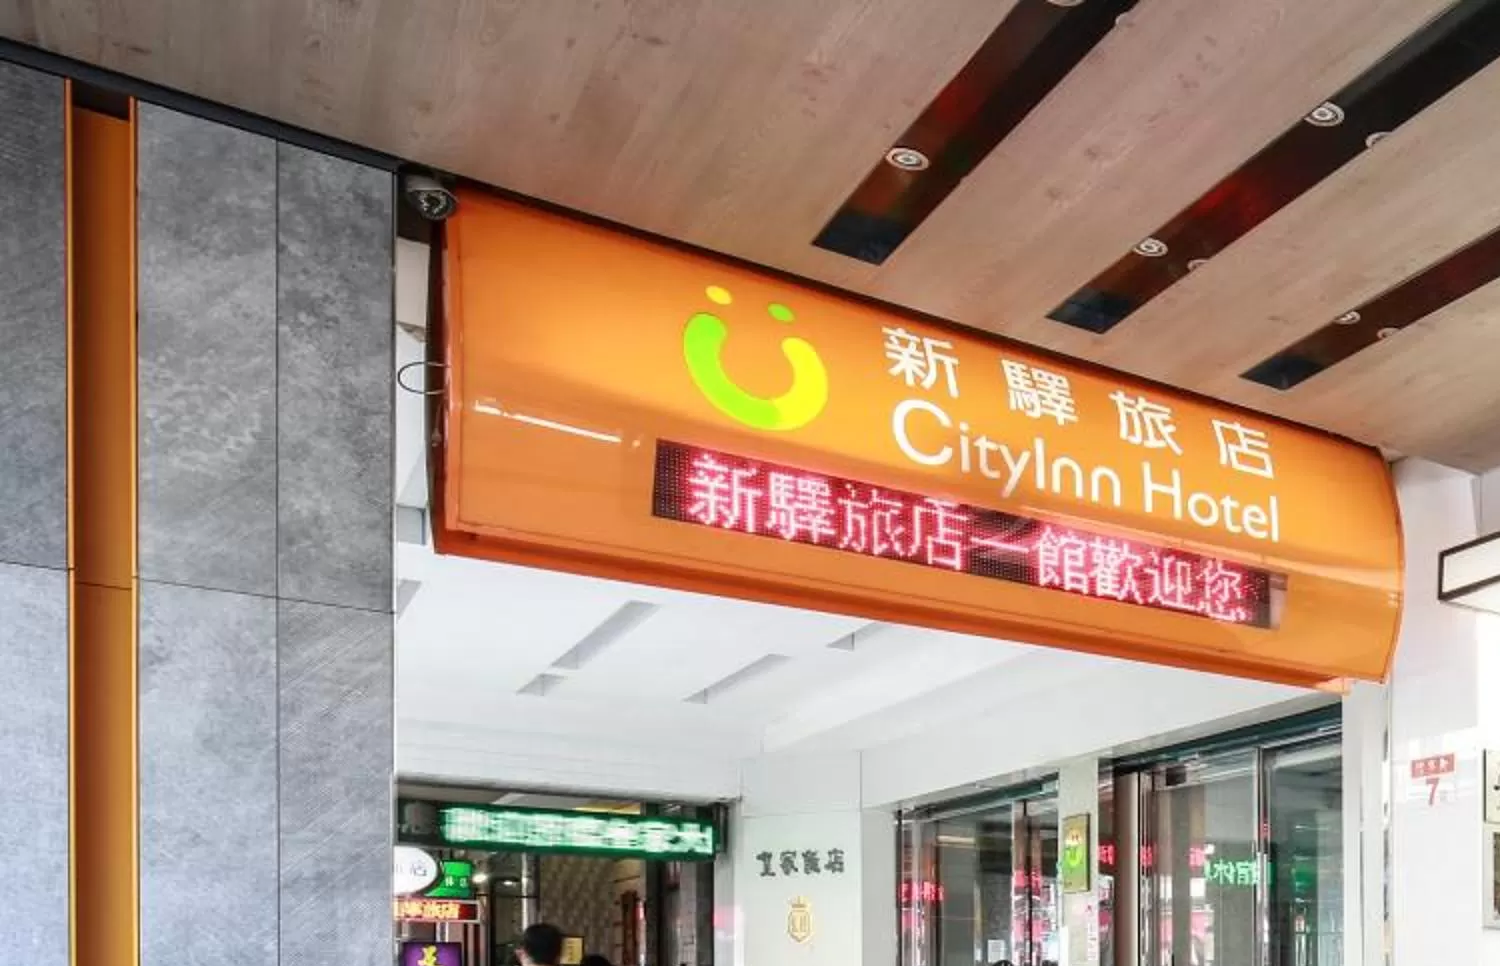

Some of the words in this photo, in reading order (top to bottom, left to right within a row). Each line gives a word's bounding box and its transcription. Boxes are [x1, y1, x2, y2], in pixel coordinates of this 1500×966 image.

[882, 327, 1273, 478] 新驛旅店
[892, 399, 1121, 506] CityInn
[1142, 461, 1280, 542] Hotel
[688, 453, 1248, 622] 新驛旅店一館歡迎您
[1426, 777, 1439, 806] 7
